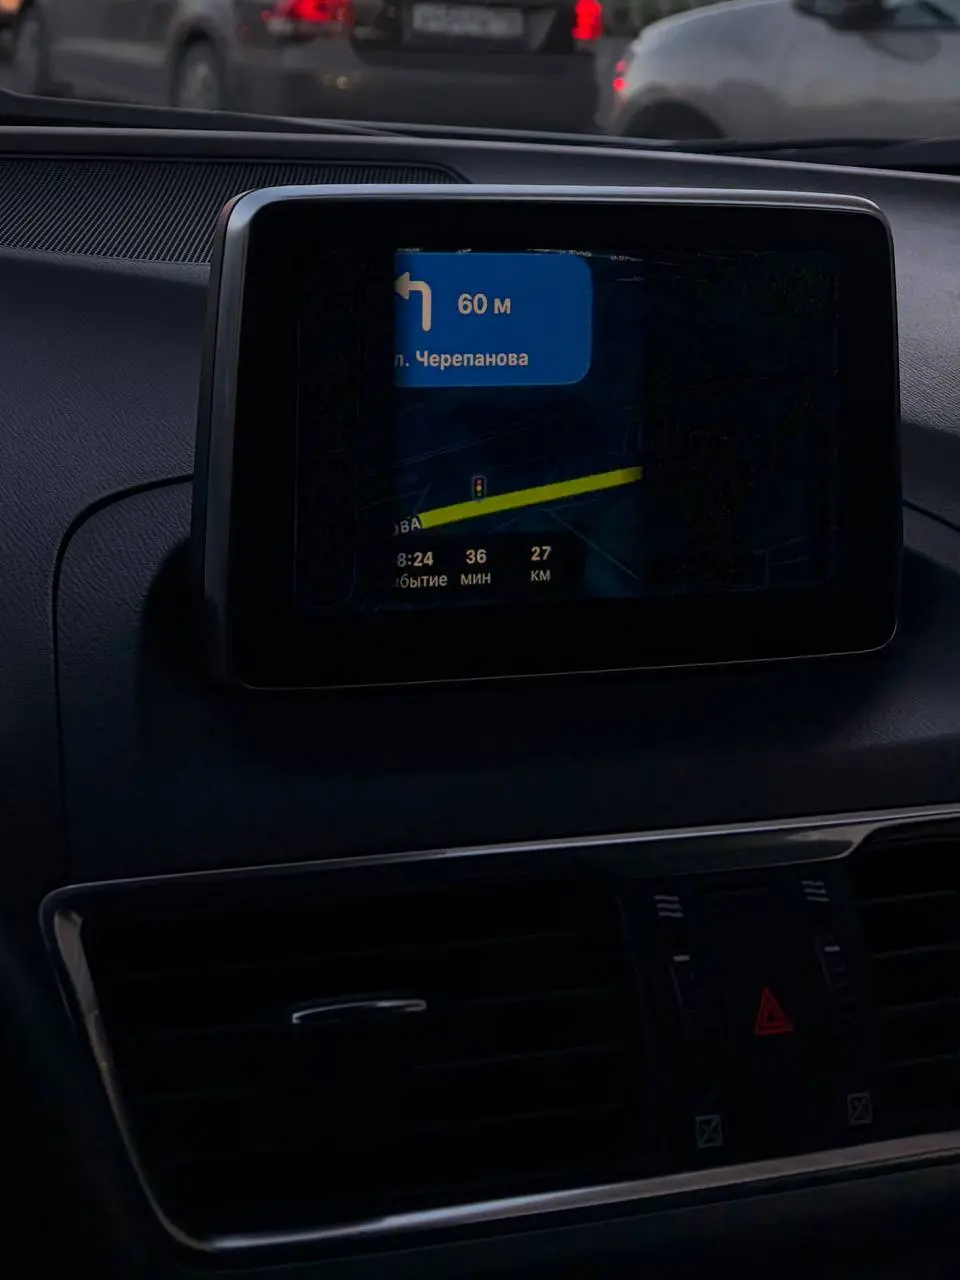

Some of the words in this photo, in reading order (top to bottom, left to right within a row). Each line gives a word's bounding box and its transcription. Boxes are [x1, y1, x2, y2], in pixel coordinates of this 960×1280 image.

[457, 293, 488, 315] 60
[493, 296, 512, 315] м
[415, 349, 529, 371] Черепанова
[394, 551, 435, 568] 8:24
[465, 548, 488, 565] 36
[531, 545, 552, 562] 27
[460, 571, 492, 587] мин
[530, 568, 551, 583] км
